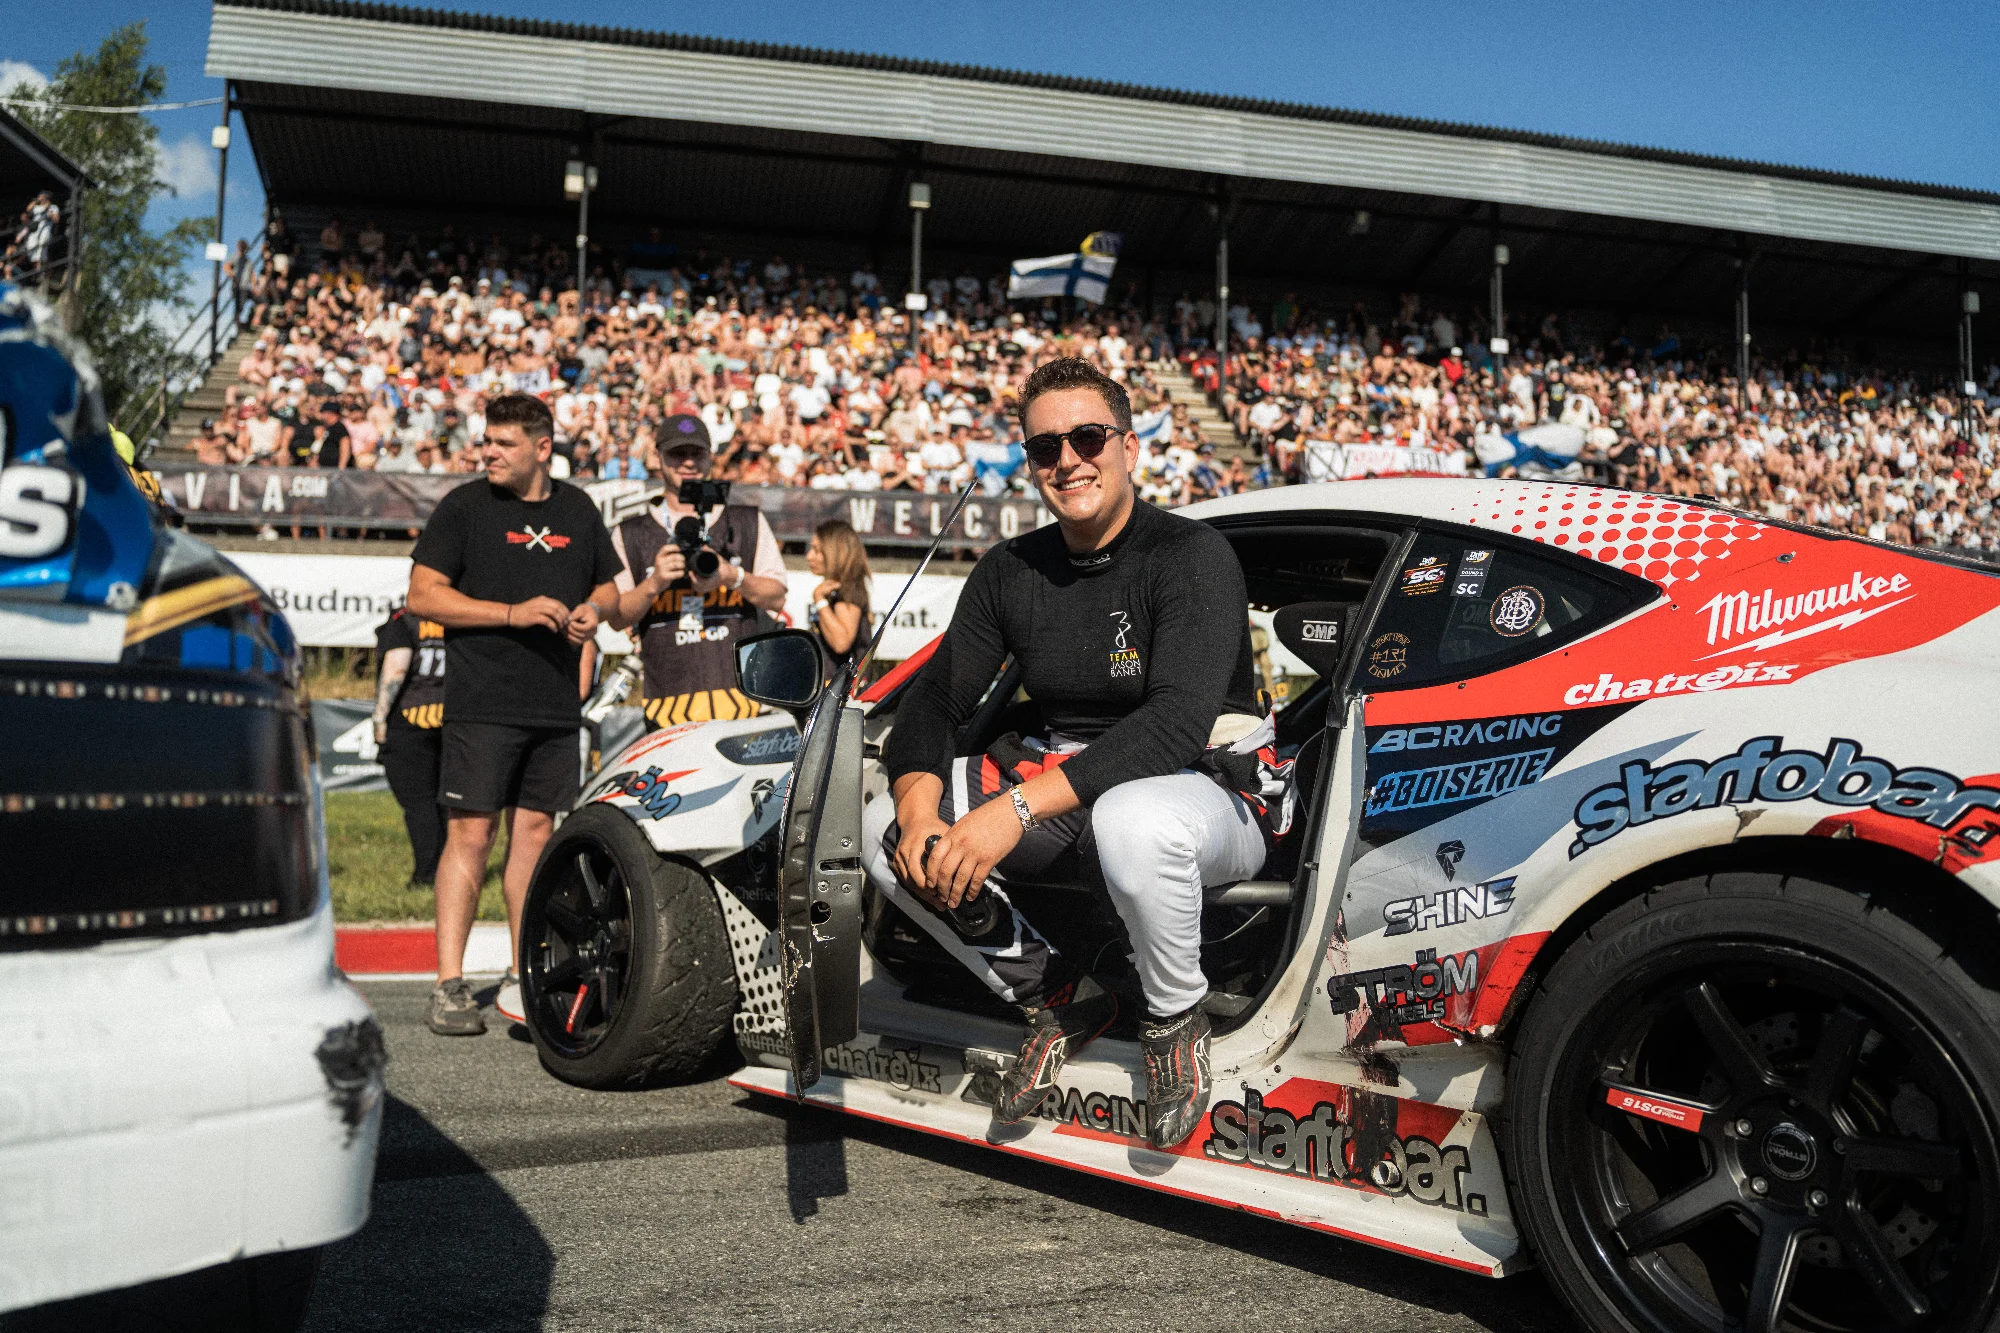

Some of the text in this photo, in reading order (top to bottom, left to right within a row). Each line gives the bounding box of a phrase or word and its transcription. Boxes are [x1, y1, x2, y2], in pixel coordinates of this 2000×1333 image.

[1456, 583, 1479, 595] SC
[1694, 571, 1913, 645] Milwaukee
[1302, 622, 1338, 641] OMP
[1110, 650, 1138, 662] TEAM
[1111, 659, 1141, 670] JASON
[1368, 749, 1553, 816] #BOISERIE
[1382, 875, 1518, 937] SHINE
[1327, 947, 1479, 1016] STRÖM
[1389, 1000, 1446, 1026] HEELS
[1622, 1097, 1663, 1115] DS15
